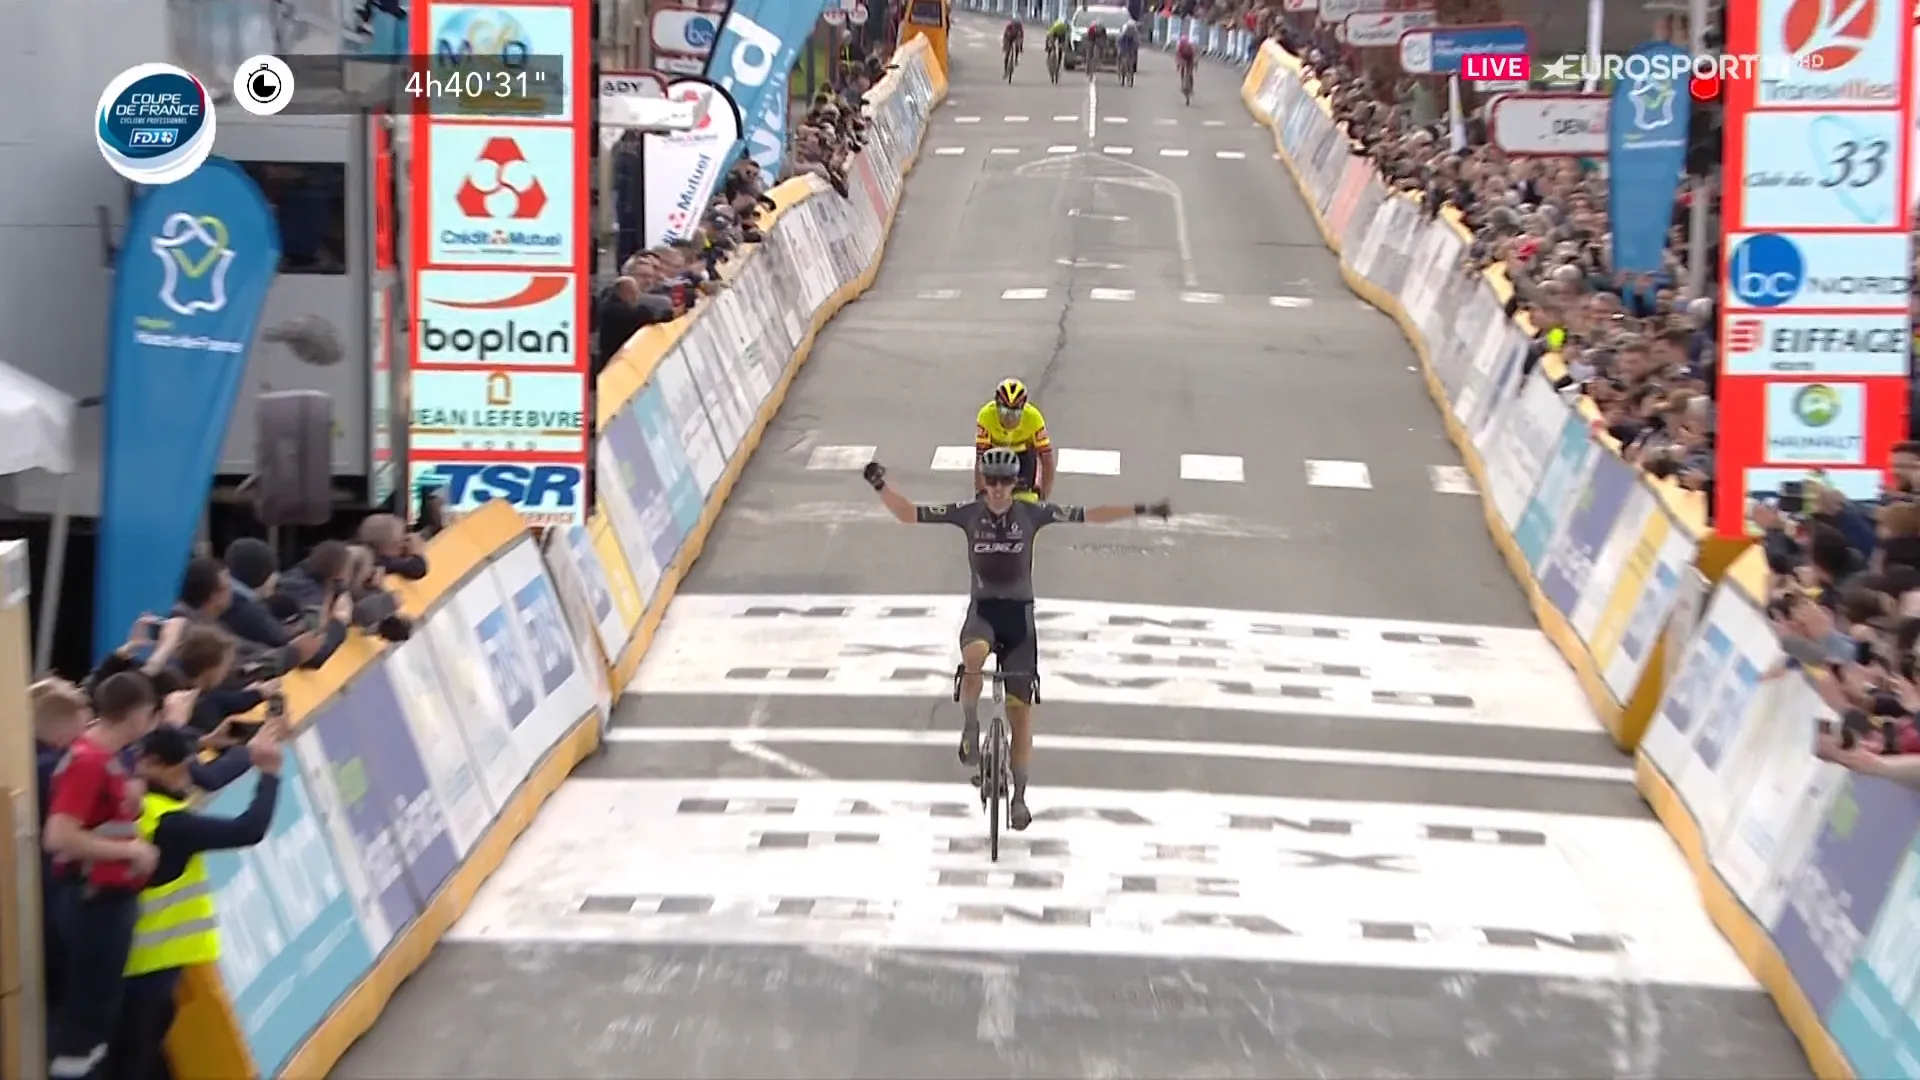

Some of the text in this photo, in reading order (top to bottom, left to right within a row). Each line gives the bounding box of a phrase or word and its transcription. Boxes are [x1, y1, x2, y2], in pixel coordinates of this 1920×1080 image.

[1819, 140, 1890, 188] 33
[440, 229, 562, 247] Crédit Mutuel
[1738, 244, 1797, 298] bc
[418, 319, 569, 361] boplan
[1772, 327, 1909, 353] EIFFAGE
[472, 409, 584, 428] LEFEBVRE
